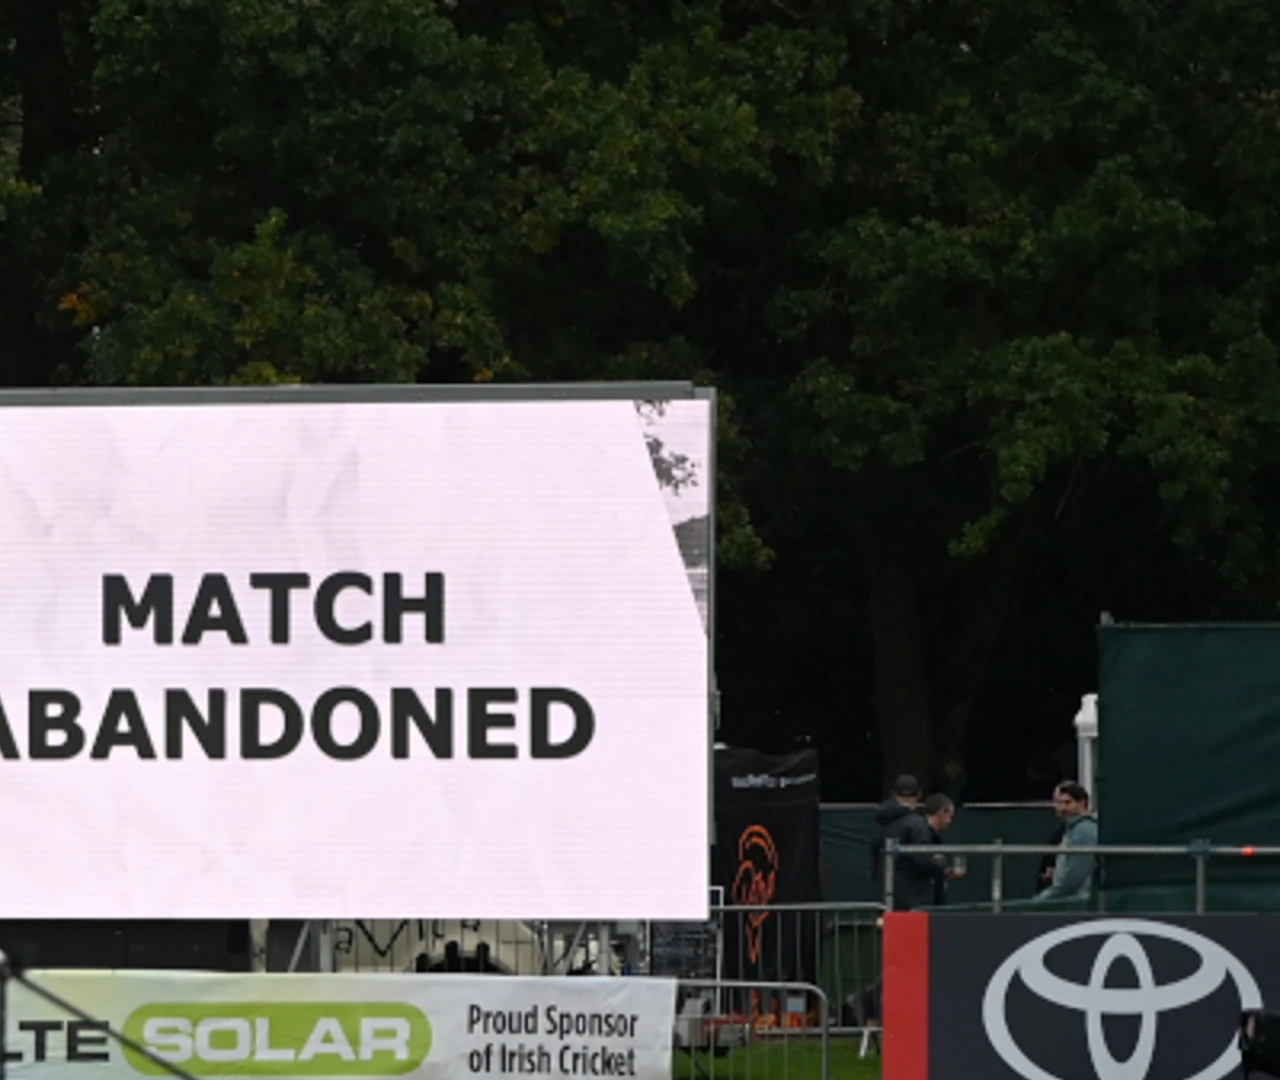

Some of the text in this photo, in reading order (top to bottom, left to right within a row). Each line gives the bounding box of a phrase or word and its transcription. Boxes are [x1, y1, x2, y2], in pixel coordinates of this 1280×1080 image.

[101, 571, 446, 645] MATCH
[143, 1016, 411, 1063] SOLAR
[468, 1003, 639, 1041] Proud Sponsor
[469, 1043, 635, 1077] of Irish Cricket
